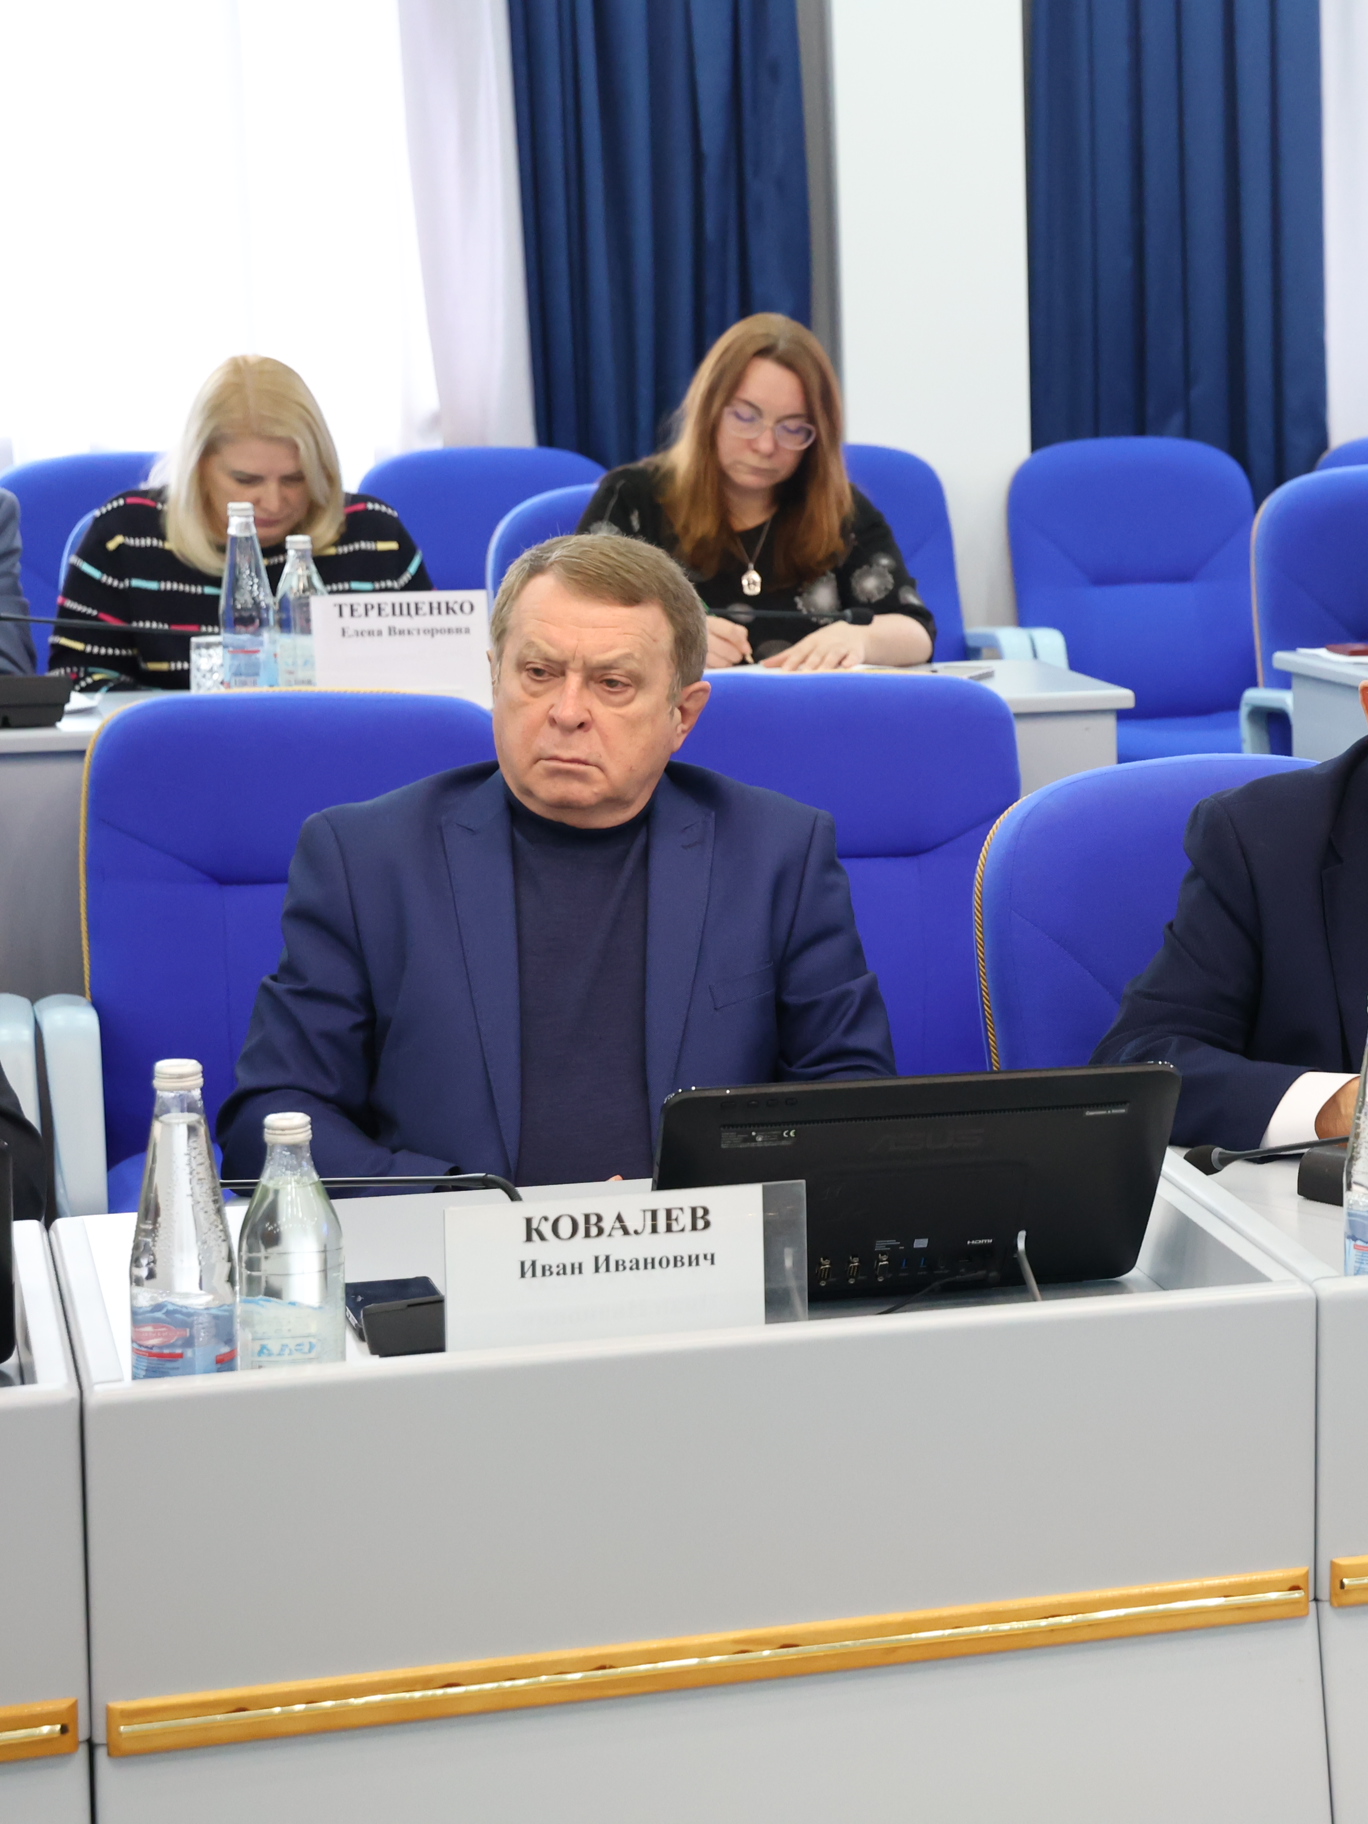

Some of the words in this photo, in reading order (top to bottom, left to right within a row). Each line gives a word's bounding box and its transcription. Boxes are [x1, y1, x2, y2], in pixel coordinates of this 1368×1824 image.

[334, 599, 475, 619] ТЕРЕЩЕНКО
[341, 627, 383, 638] Елена
[388, 625, 471, 640] Викторовна
[523, 1205, 712, 1243] КОВАЛЕВ
[518, 1259, 584, 1279] Иван
[593, 1251, 716, 1274] Иванович
